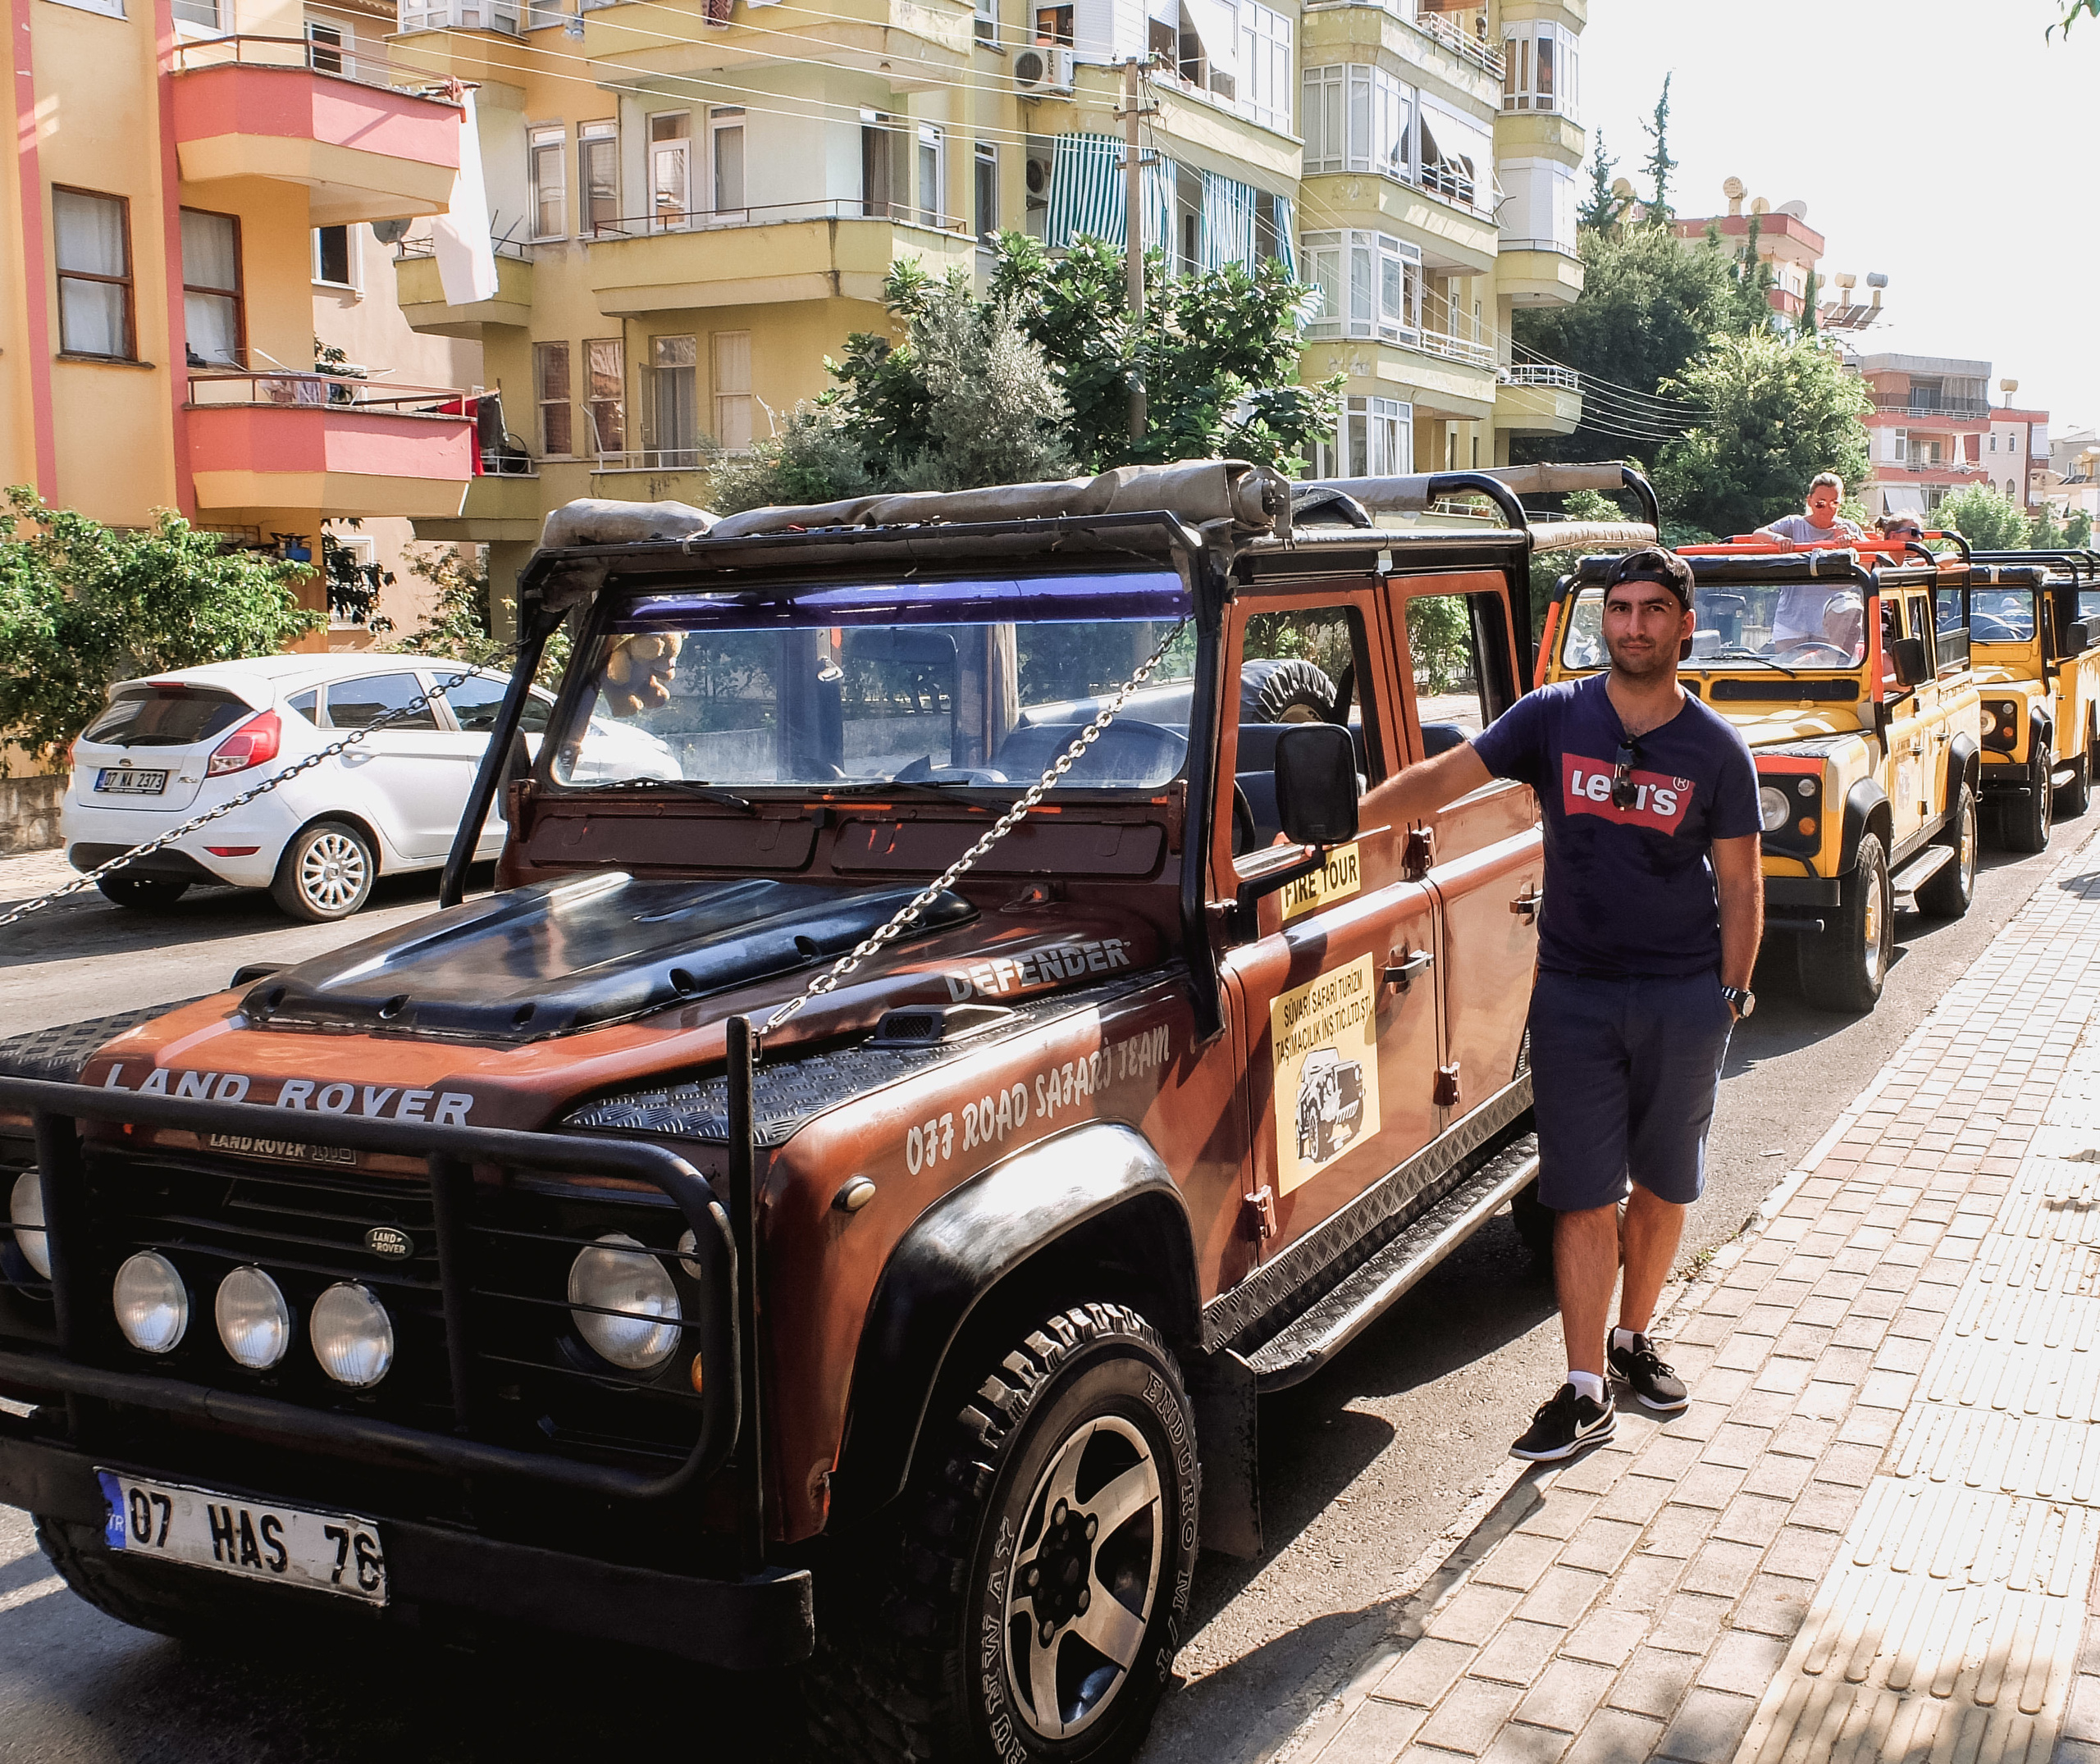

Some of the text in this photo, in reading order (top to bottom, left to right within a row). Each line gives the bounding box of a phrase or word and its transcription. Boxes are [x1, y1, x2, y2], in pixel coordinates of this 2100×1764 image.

[104, 773, 117, 786] 07
[137, 773, 164, 787] 2373
[1571, 769, 1678, 816] Lei's
[1321, 854, 1358, 893] TOUR
[944, 938, 1131, 1002] DEFENDER
[103, 1063, 473, 1128] LAND ROVER
[906, 1112, 955, 1175] OFF
[961, 1083, 1029, 1151] ROAD
[1118, 1023, 1171, 1080] TEAM
[210, 1133, 252, 1151] LAND
[373, 1231, 396, 1243] LAND
[376, 1242, 406, 1254] ROVER
[1143, 1370, 1198, 1552] ENDURO
[128, 1487, 173, 1549] 07
[206, 1502, 288, 1574] HAS
